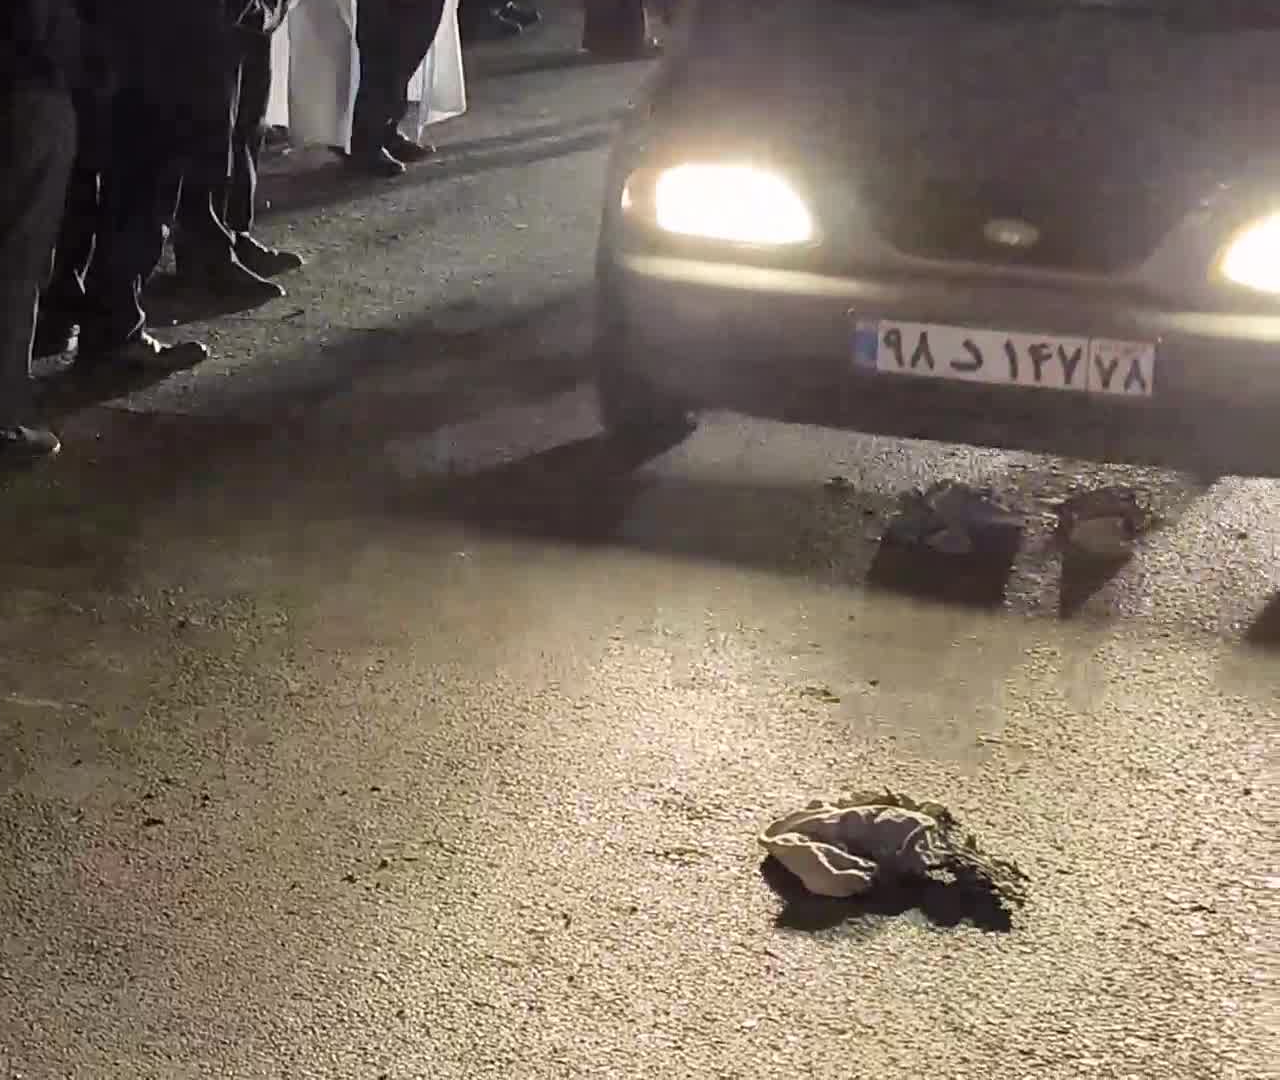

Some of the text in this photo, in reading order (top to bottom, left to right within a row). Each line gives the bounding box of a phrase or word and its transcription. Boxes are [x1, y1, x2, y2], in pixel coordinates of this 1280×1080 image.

[882, 326, 934, 370] ۹۸
[1004, 339, 1082, 385] ۱۴۷
[1094, 355, 1146, 389] ۷۸
